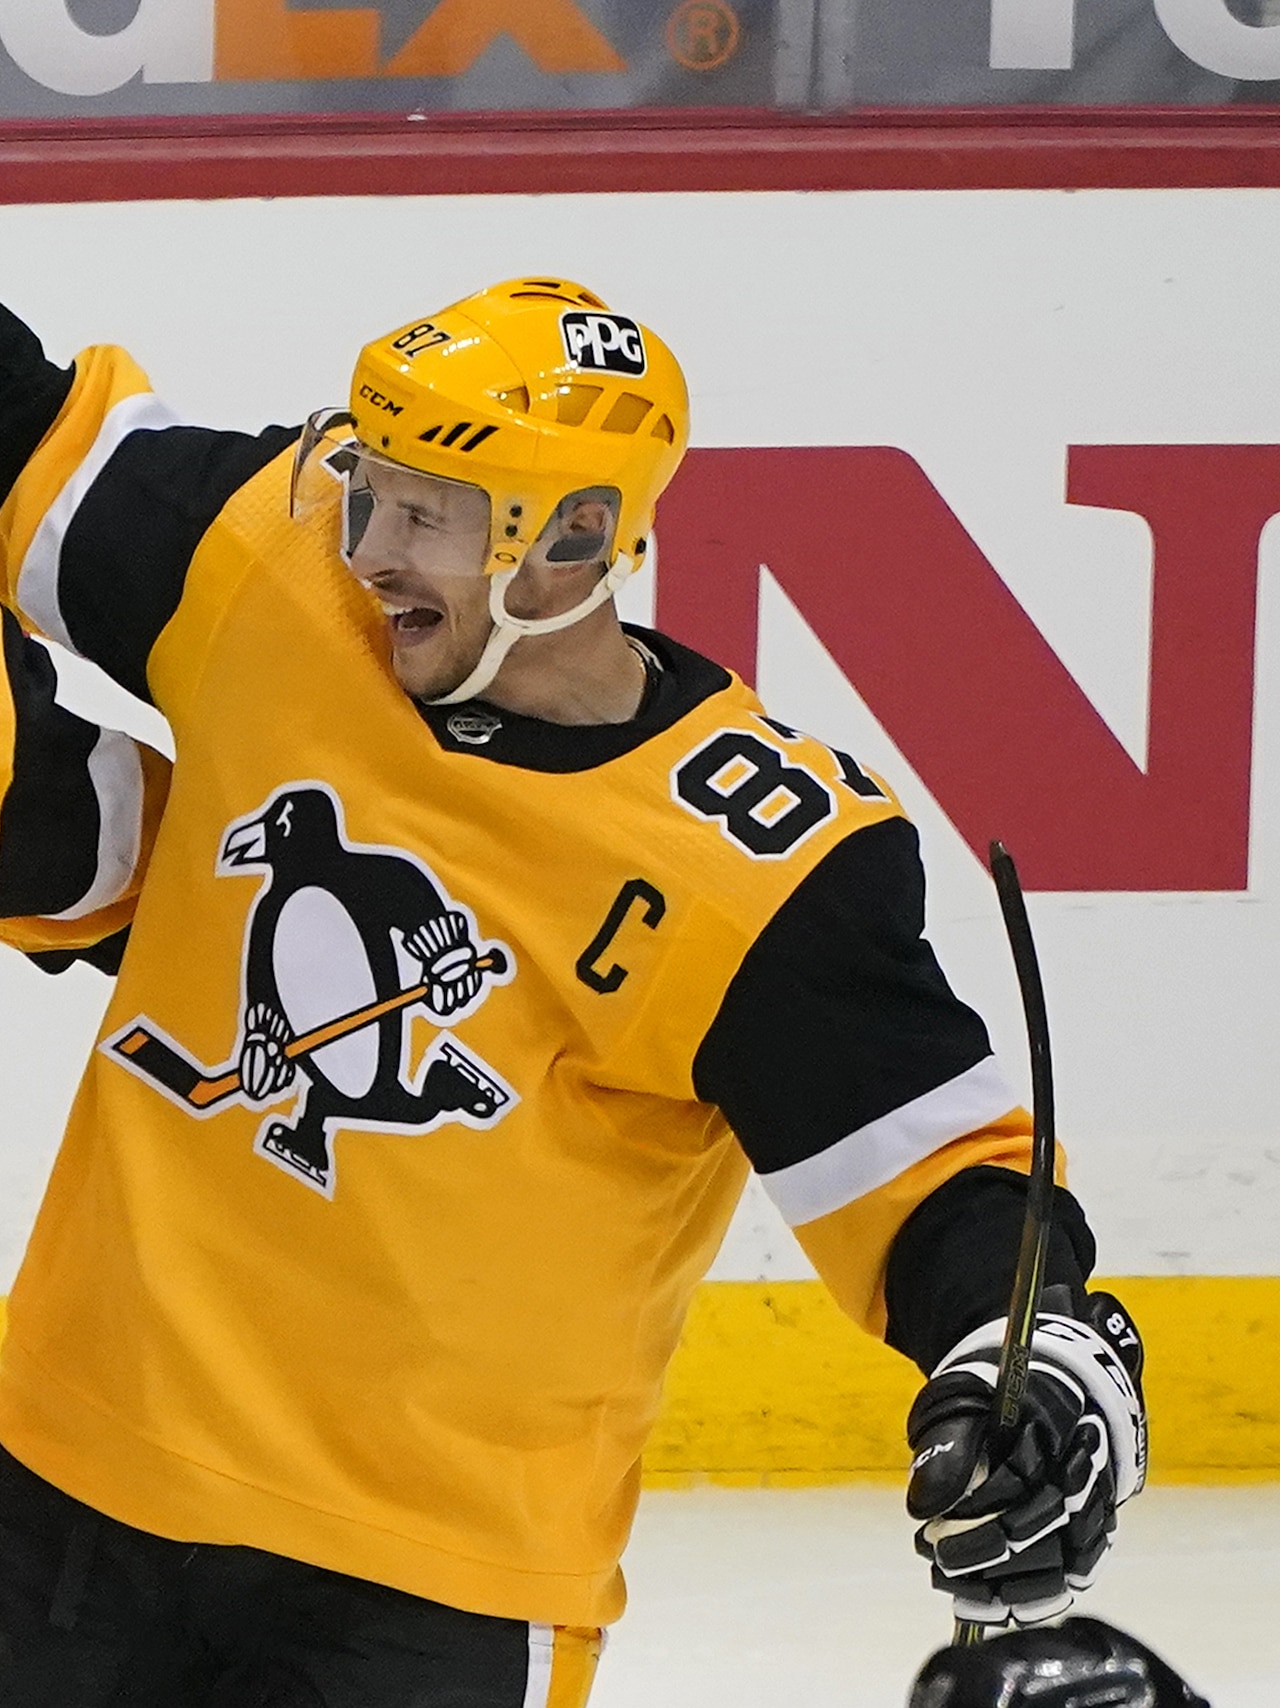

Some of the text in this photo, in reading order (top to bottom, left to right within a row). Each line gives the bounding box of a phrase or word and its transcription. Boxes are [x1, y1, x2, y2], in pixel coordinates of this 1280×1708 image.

[392, 323, 451, 359] 87
[565, 315, 643, 367] PPG
[359, 384, 405, 417] CCM
[575, 877, 667, 995] C
[1106, 1312, 1140, 1348] 87
